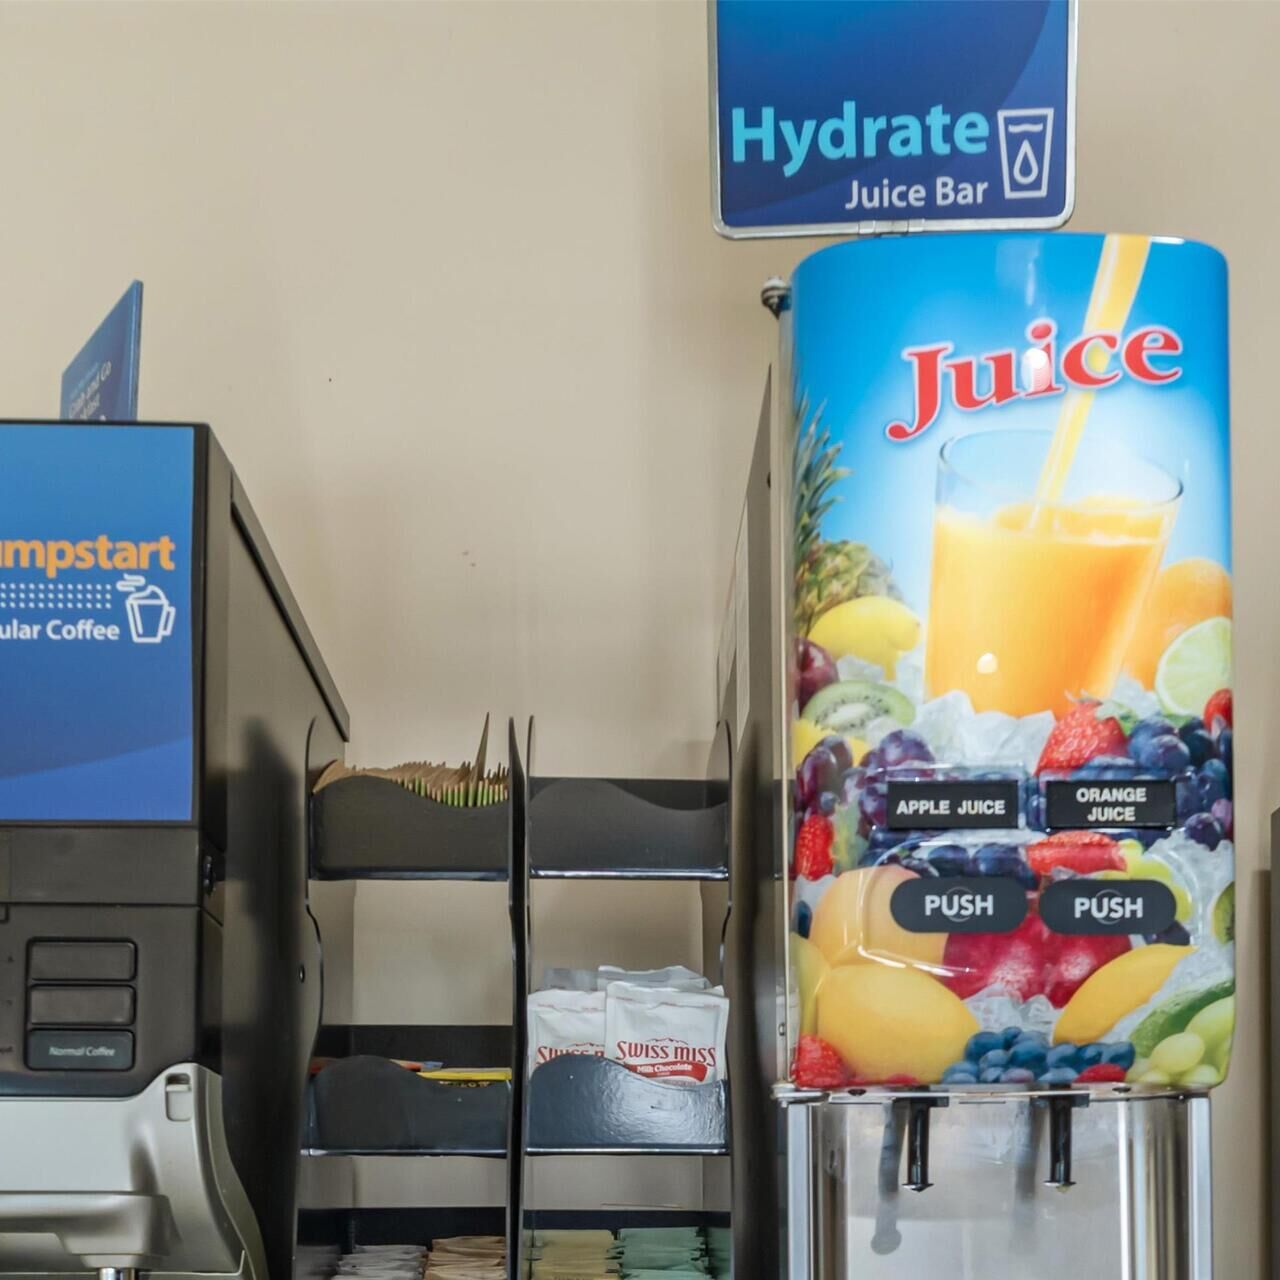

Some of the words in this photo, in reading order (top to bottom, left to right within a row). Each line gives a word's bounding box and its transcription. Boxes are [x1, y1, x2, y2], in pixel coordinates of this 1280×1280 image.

[732, 100, 990, 178] Hydrate
[845, 178, 926, 210] Juice
[936, 176, 989, 206] Bar
[886, 318, 1183, 442] Juice
[46, 619, 120, 640] Coffee
[1076, 787, 1147, 802] ORANGE
[896, 800, 951, 815] APPLE
[957, 800, 1006, 815] JUICE
[1087, 807, 1136, 822] JUICE
[925, 895, 994, 917] PUSH
[1074, 897, 1144, 919] PUSH
[48, 1046, 85, 1056] Normal
[86, 1046, 116, 1057] Coffee
[616, 1040, 670, 1060] SWISS
[654, 1063, 693, 1073] Chocolate
